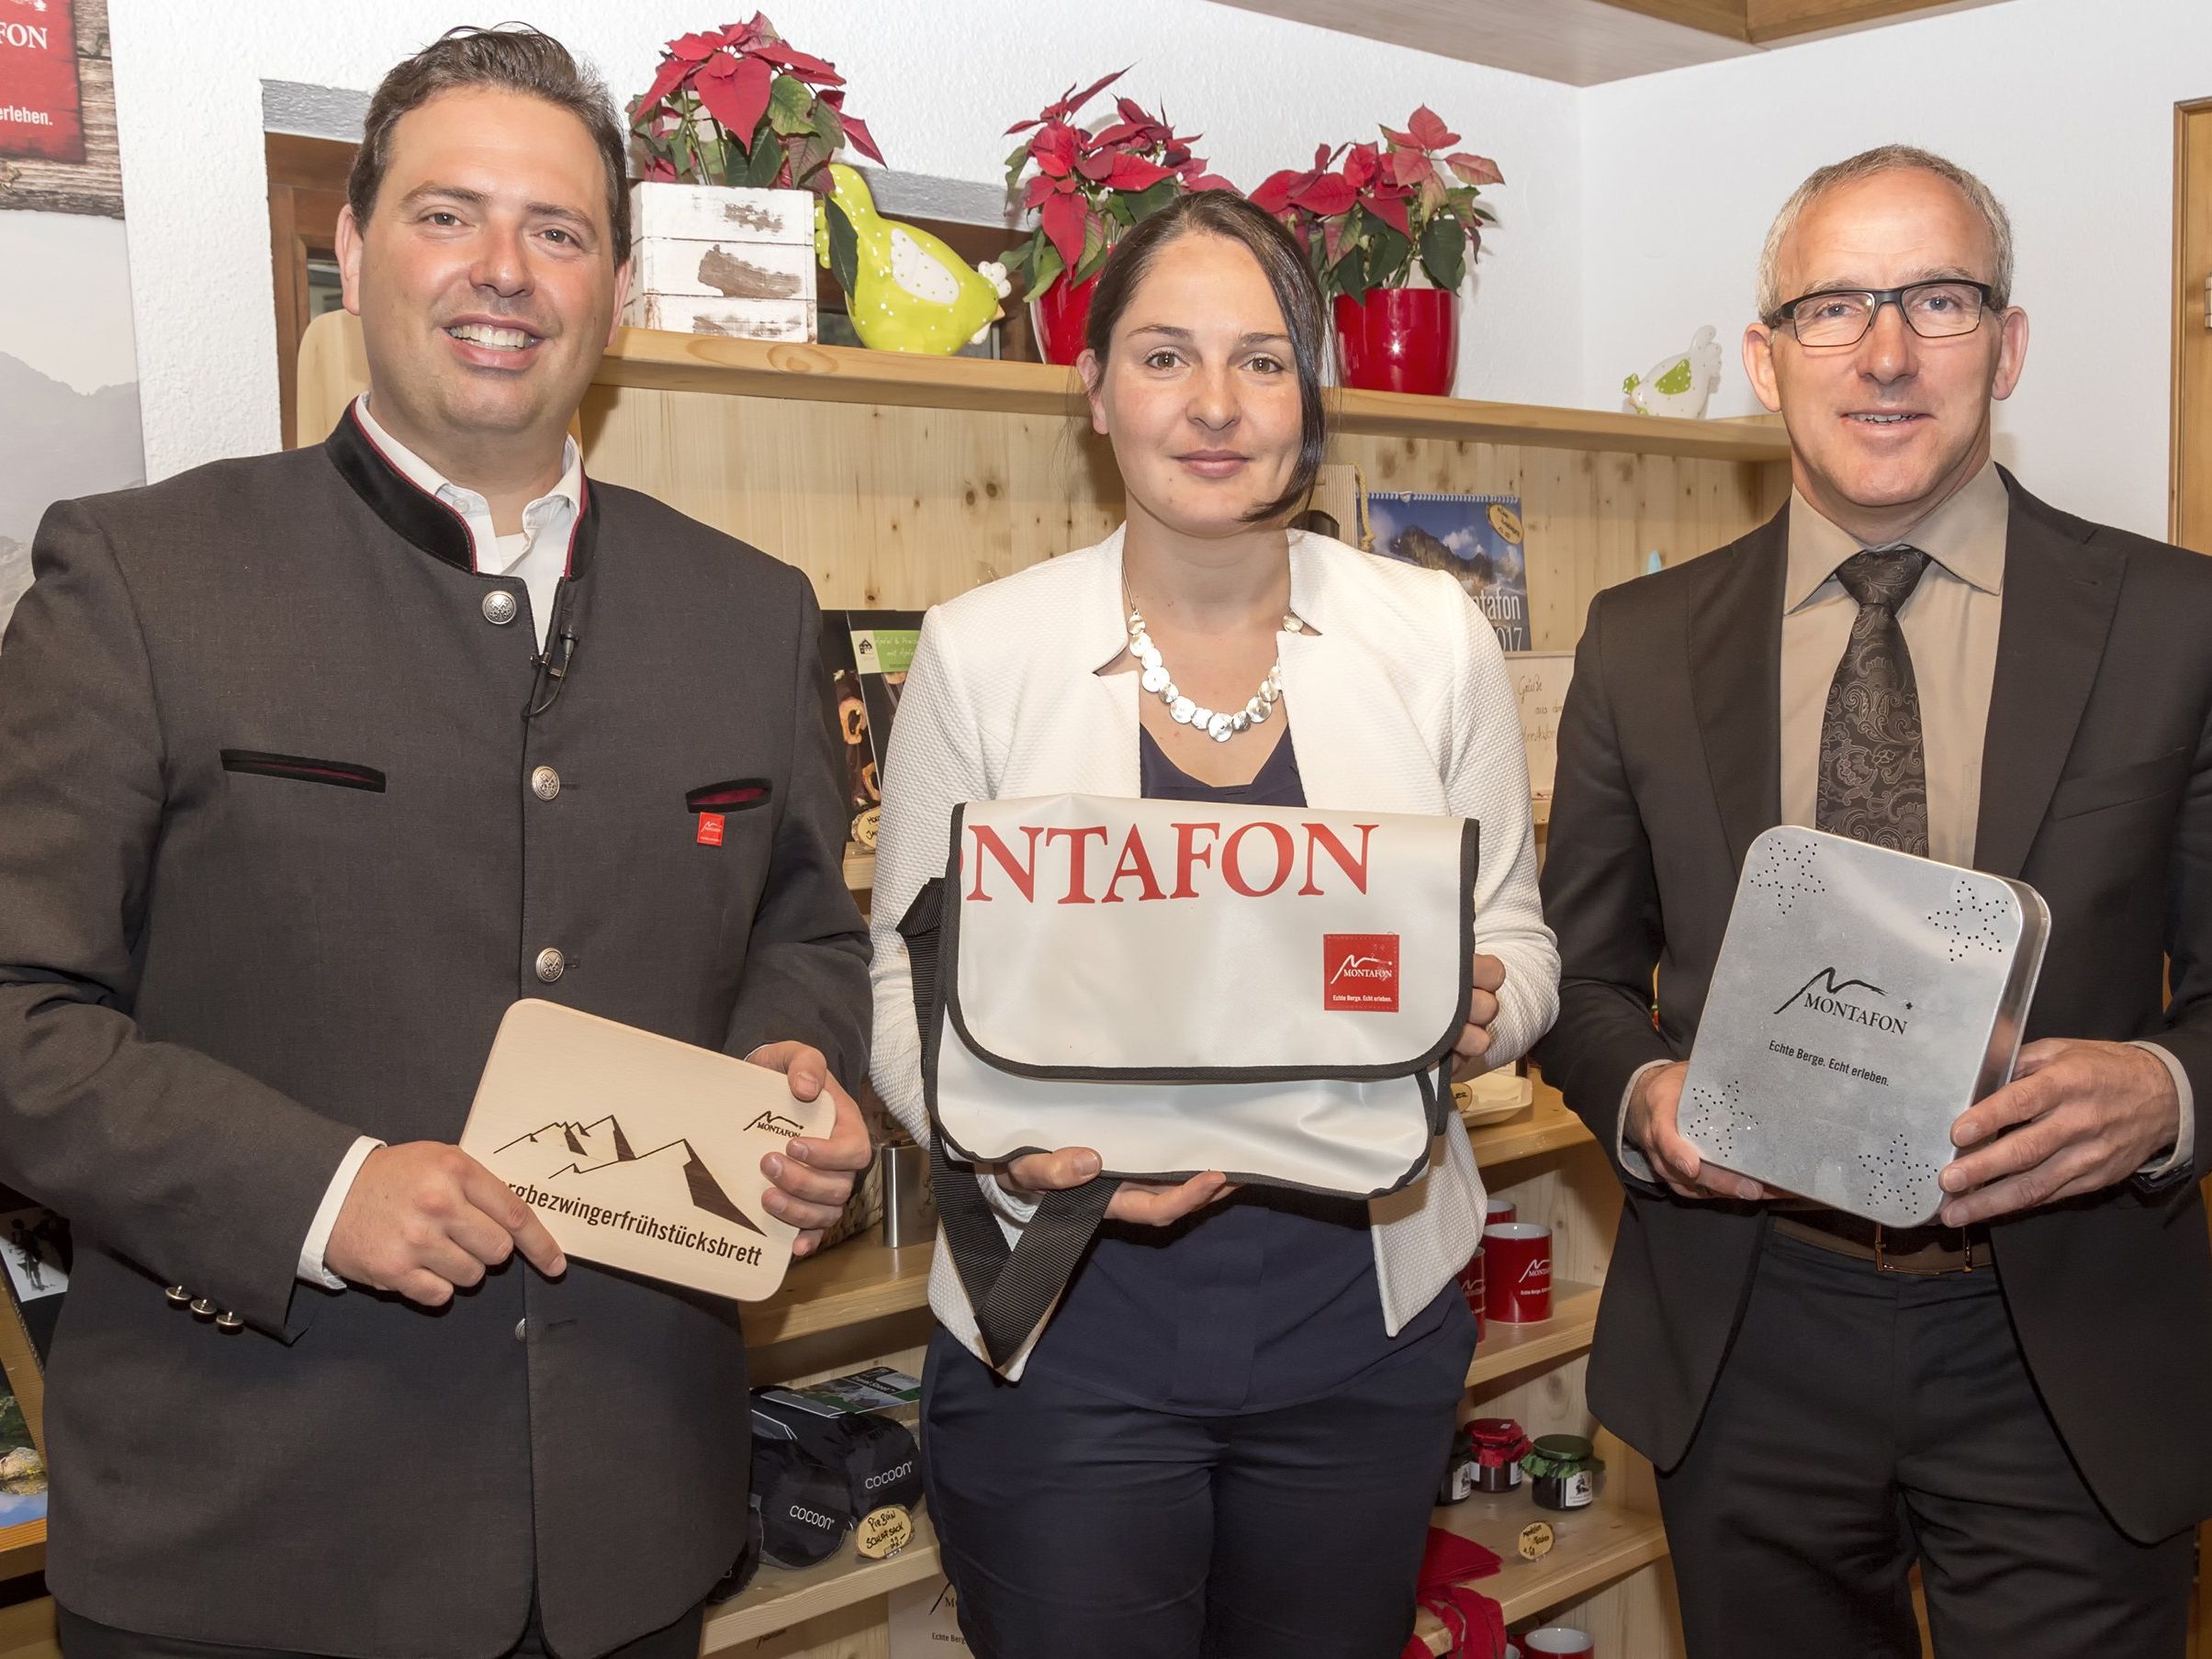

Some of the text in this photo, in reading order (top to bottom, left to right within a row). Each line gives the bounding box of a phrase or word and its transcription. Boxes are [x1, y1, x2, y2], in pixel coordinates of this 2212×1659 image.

[960, 821, 1379, 903] NTAFON
[1342, 969, 1392, 978] MONTAFON
[1803, 992, 1908, 1035] MONTAFON
[1768, 1040, 1890, 1087] Echte Berge. Echt erleben.
[757, 1122, 801, 1138] MONTAFON
